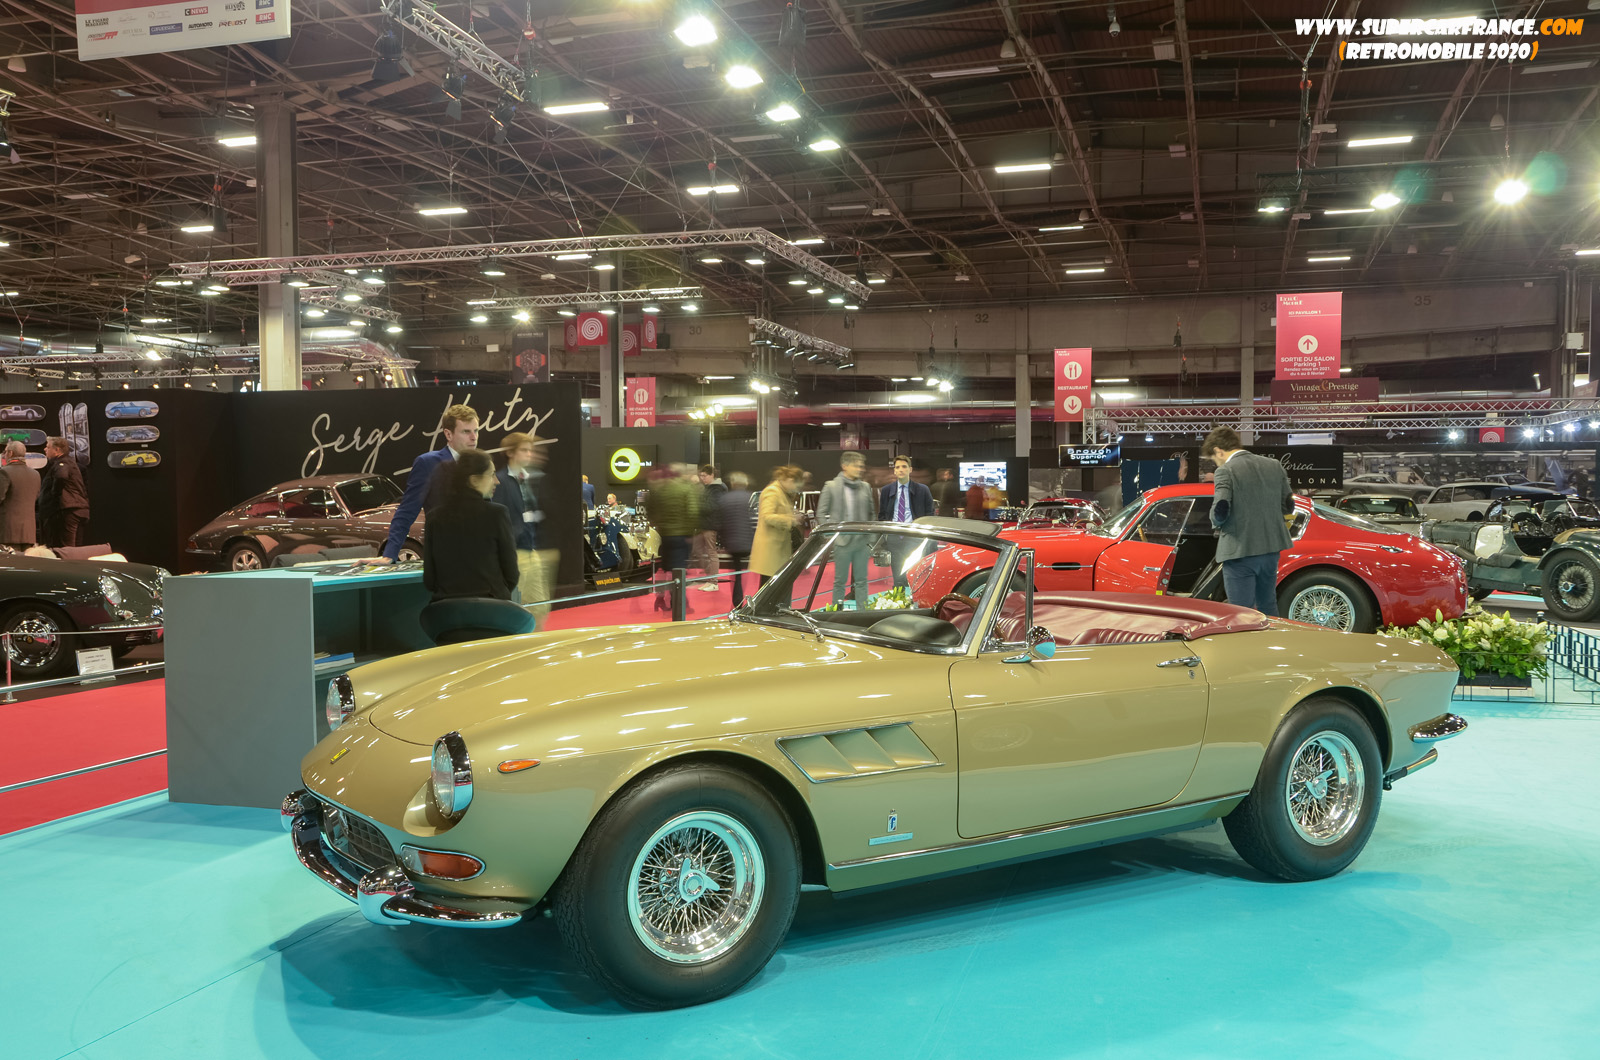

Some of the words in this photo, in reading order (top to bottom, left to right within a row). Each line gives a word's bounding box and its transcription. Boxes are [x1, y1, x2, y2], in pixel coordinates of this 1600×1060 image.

[1414, 295, 1432, 307] 35
[975, 313, 989, 324] 32
[689, 326, 702, 335] 30
[1328, 382, 1359, 391] Prestige
[301, 413, 414, 479] Serge
